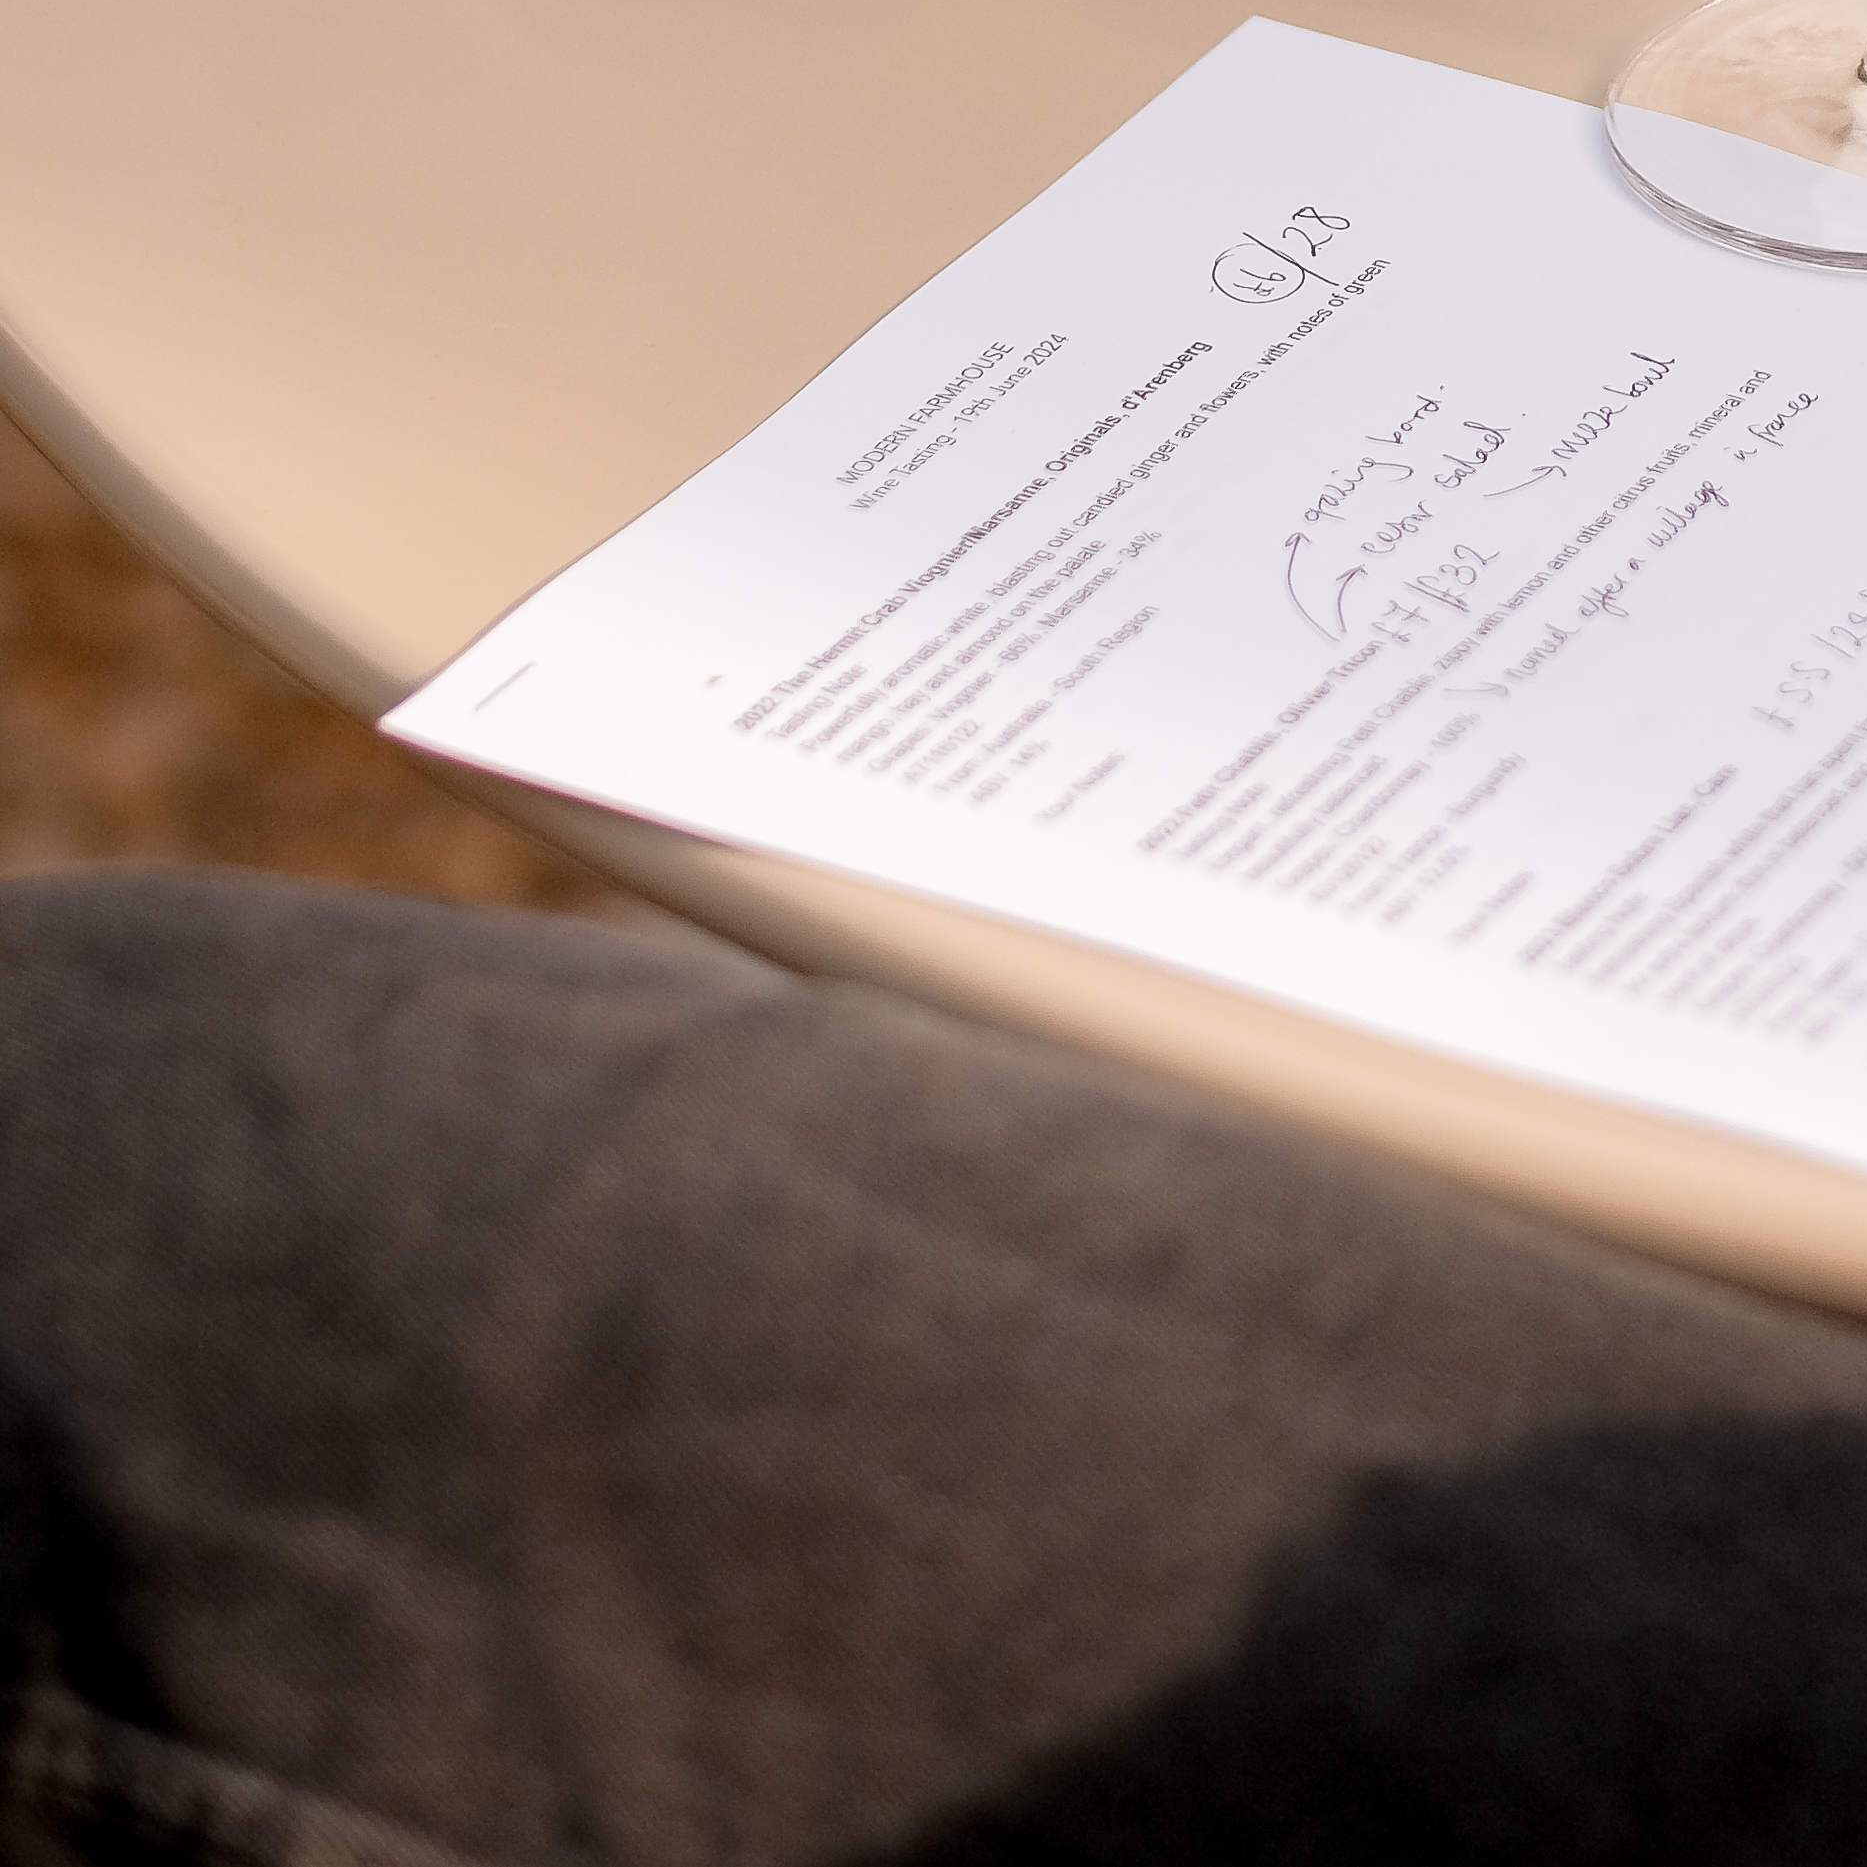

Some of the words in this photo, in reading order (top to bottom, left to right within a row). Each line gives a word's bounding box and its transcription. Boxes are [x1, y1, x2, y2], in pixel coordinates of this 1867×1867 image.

[836, 423, 918, 484] MODERN
[907, 341, 1014, 424] FARMHOUSE
[849, 478, 900, 509] Wine
[888, 434, 957, 475] Tasting
[953, 397, 996, 423] 19th
[988, 366, 1032, 396] June
[1022, 333, 1067, 366] 2024
[732, 695, 783, 731] 2022
[769, 669, 815, 695] The
[805, 625, 871, 670] Hermit
[860, 595, 908, 626] Crab
[899, 476, 1055, 592] Viognier/Marsanne,
[1045, 413, 1128, 472] Originals,
[1121, 341, 1214, 410] d'Arenberg
[799, 687, 887, 752] Powerfully
[881, 634, 951, 689] aromatic
[944, 600, 996, 635] white,
[985, 549, 1057, 597] blasting
[1046, 527, 1079, 548] out
[1072, 477, 1135, 527] candied
[1129, 439, 1177, 480] ginger
[1174, 413, 1209, 439] and
[1198, 369, 1266, 413] flowers,
[1256, 341, 1294, 365] with
[1287, 308, 1333, 341] notes
[1327, 292, 1350, 307] of
[1343, 259, 1391, 295] green
[1432, 636, 1481, 670] zippy
[1475, 610, 1509, 636] with
[1499, 571, 1553, 610] lemon
[1546, 544, 1581, 570] and
[1575, 510, 1616, 544] other
[1612, 475, 1656, 510] citrus
[1645, 442, 1698, 474] fruits,
[1688, 393, 1745, 438] mineral
[1738, 369, 1772, 394] and
[891, 689, 931, 714] hay
[923, 663, 960, 691] and
[953, 616, 1015, 665] almond
[1009, 599, 1036, 617] on
[1025, 578, 1061, 599] the
[928, 670, 996, 720] Viognier
[1036, 566, 1118, 628] Marsanne
[1118, 531, 1162, 558] 34%
[982, 699, 1054, 755] Australia
[1052, 650, 1107, 690] South
[1096, 605, 1160, 650] Region
[1276, 679, 1332, 724] Olivier
[1325, 639, 1386, 678] Tricon
